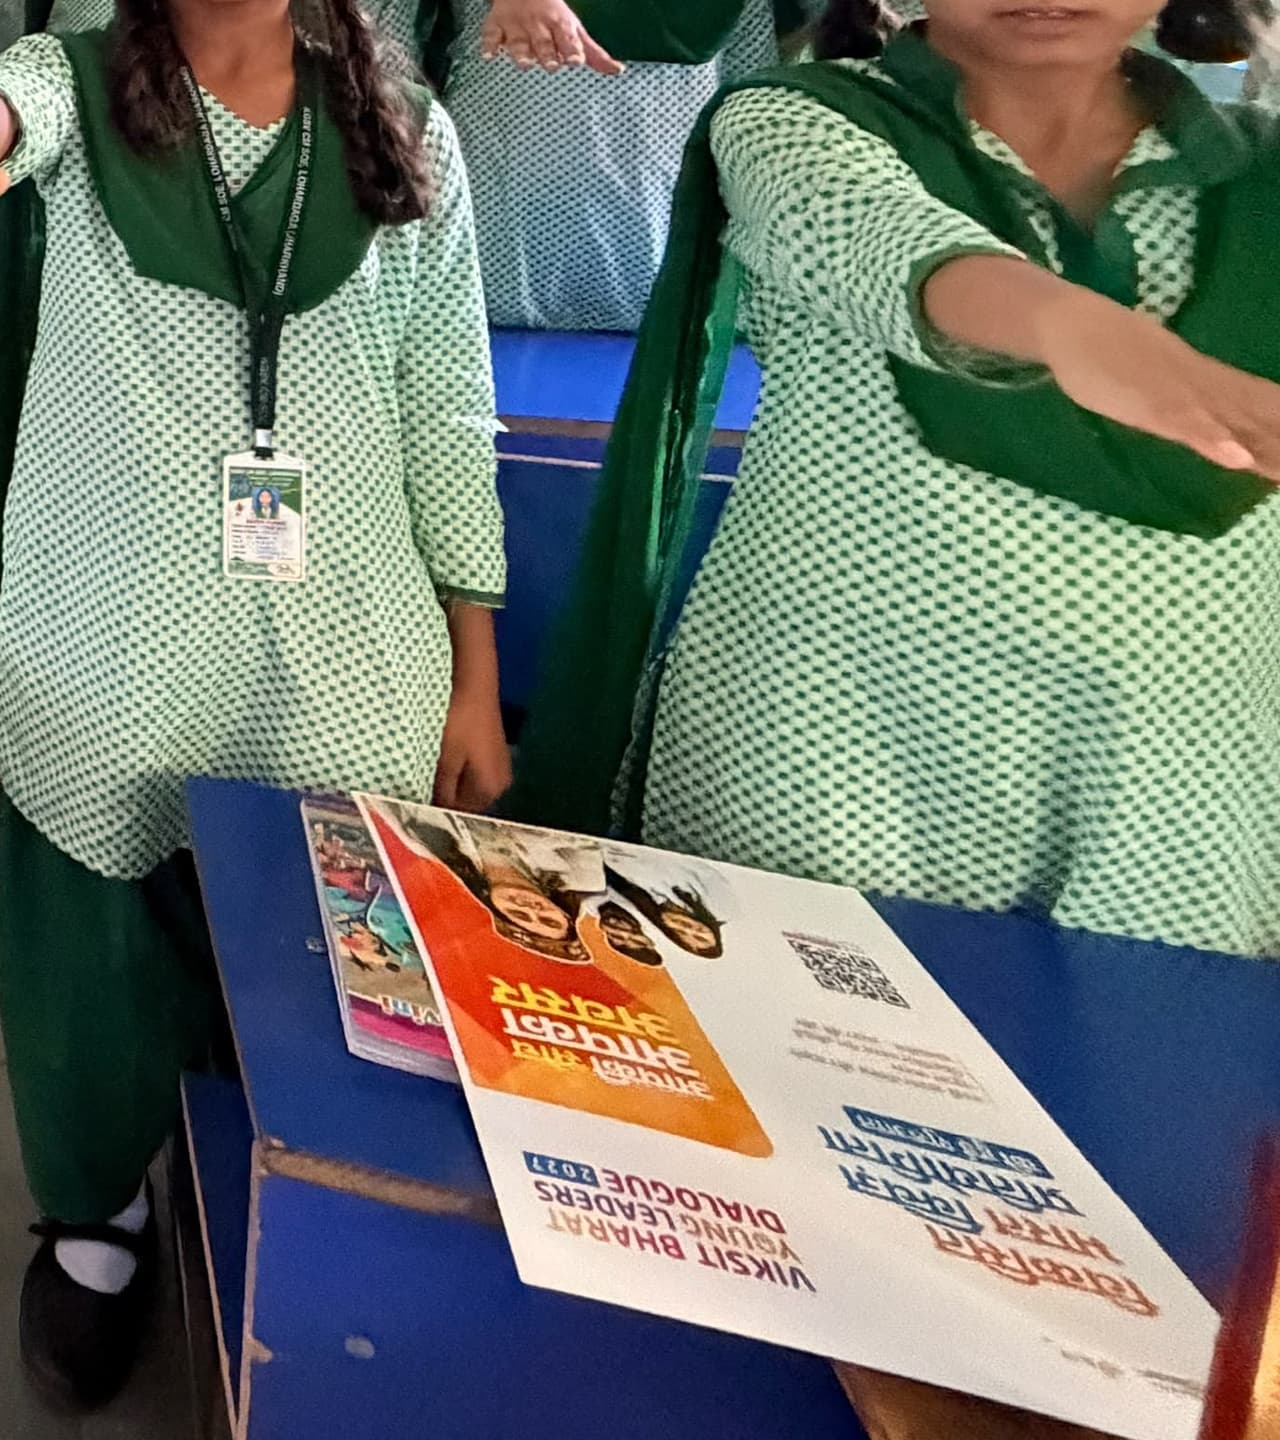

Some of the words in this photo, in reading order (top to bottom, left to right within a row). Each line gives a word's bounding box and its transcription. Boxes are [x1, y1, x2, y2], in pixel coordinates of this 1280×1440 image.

[287, 168, 309, 230] LOHARDAGA
[485, 975, 678, 1042] अवसर
[500, 1007, 702, 1077] आपका
[511, 1038, 581, 1070] सोच
[590, 1055, 714, 1101] आपकी
[530, 1155, 592, 1183] 2027
[816, 1124, 1087, 1219] प्रतियोगिता
[533, 1179, 677, 1231] LEADERS
[600, 1168, 787, 1235] DIALOGUE
[545, 1206, 687, 1261] BHARAT
[680, 1213, 803, 1266] YOUNG
[981, 1207, 1125, 1266] भारत
[696, 1242, 817, 1293] VIKSIT
[923, 1223, 1160, 1318] विकसित
